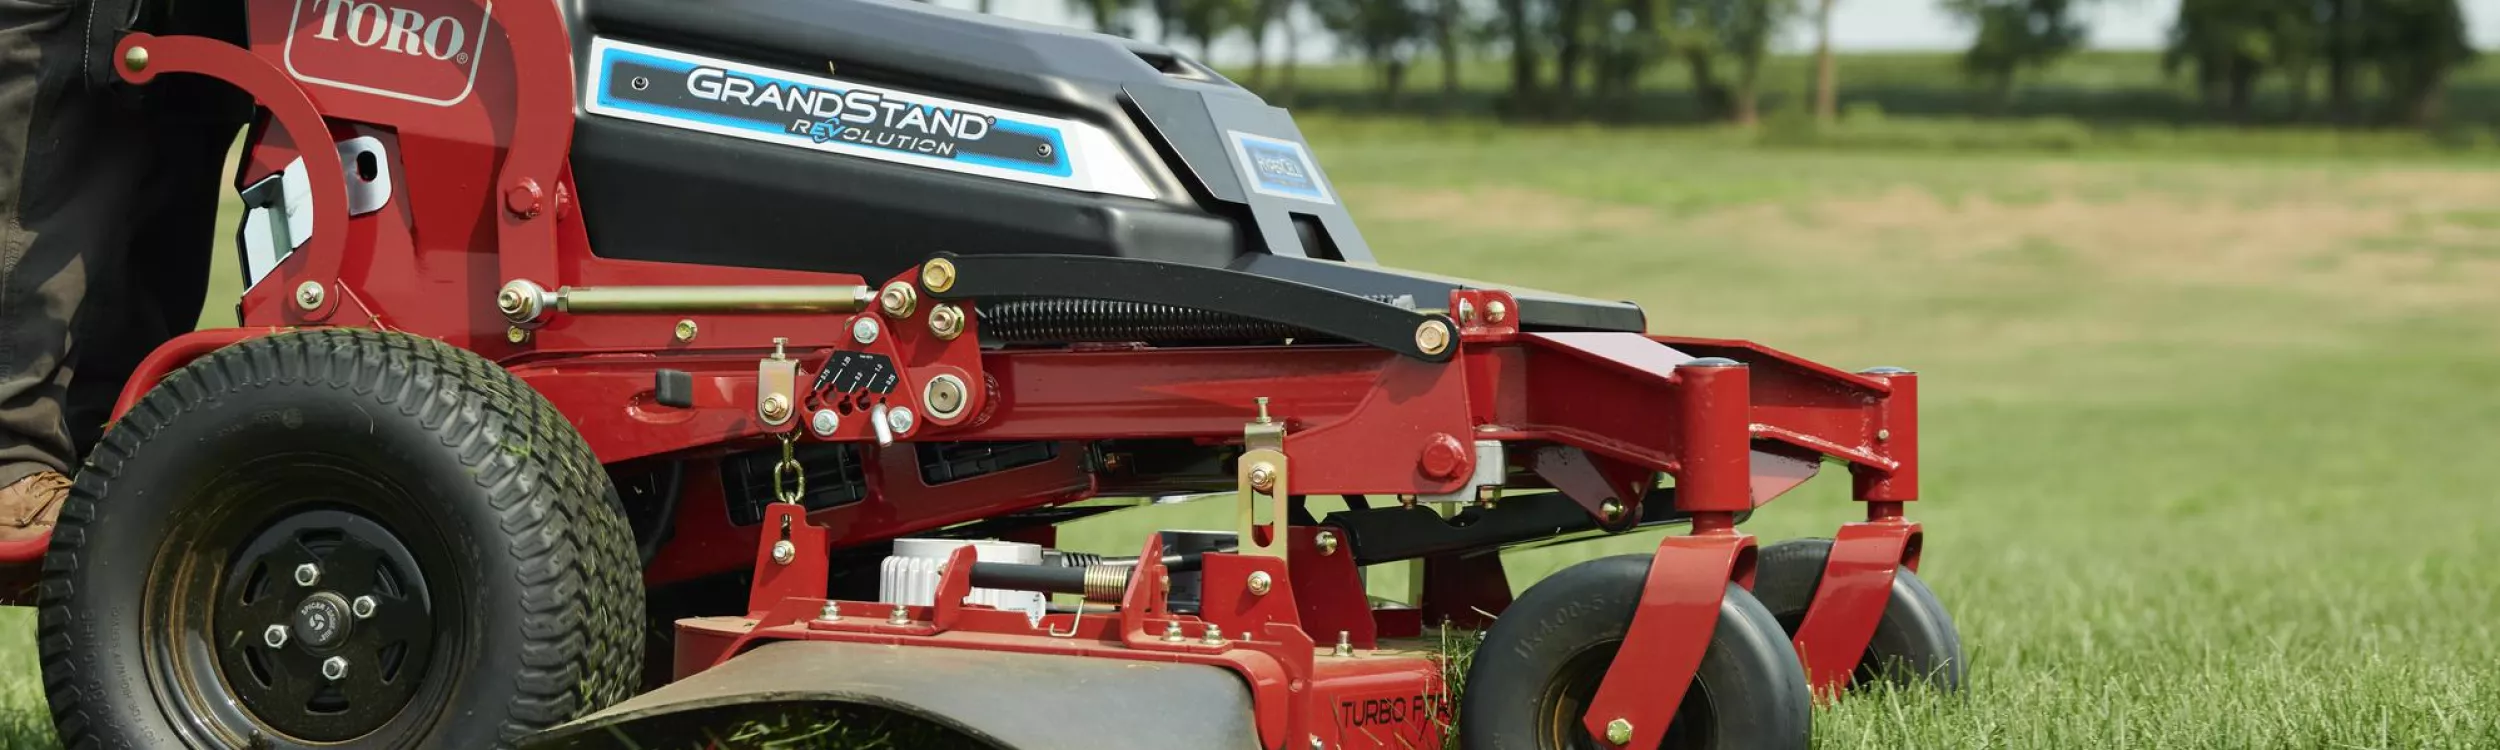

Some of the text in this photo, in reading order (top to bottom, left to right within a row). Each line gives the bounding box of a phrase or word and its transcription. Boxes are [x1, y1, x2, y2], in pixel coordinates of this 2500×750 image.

[312, 0, 465, 60] TORO
[686, 67, 990, 141] GRANDSTAND
[790, 118, 956, 157] REVOLUTION
[1341, 696, 1407, 729] TURBO
